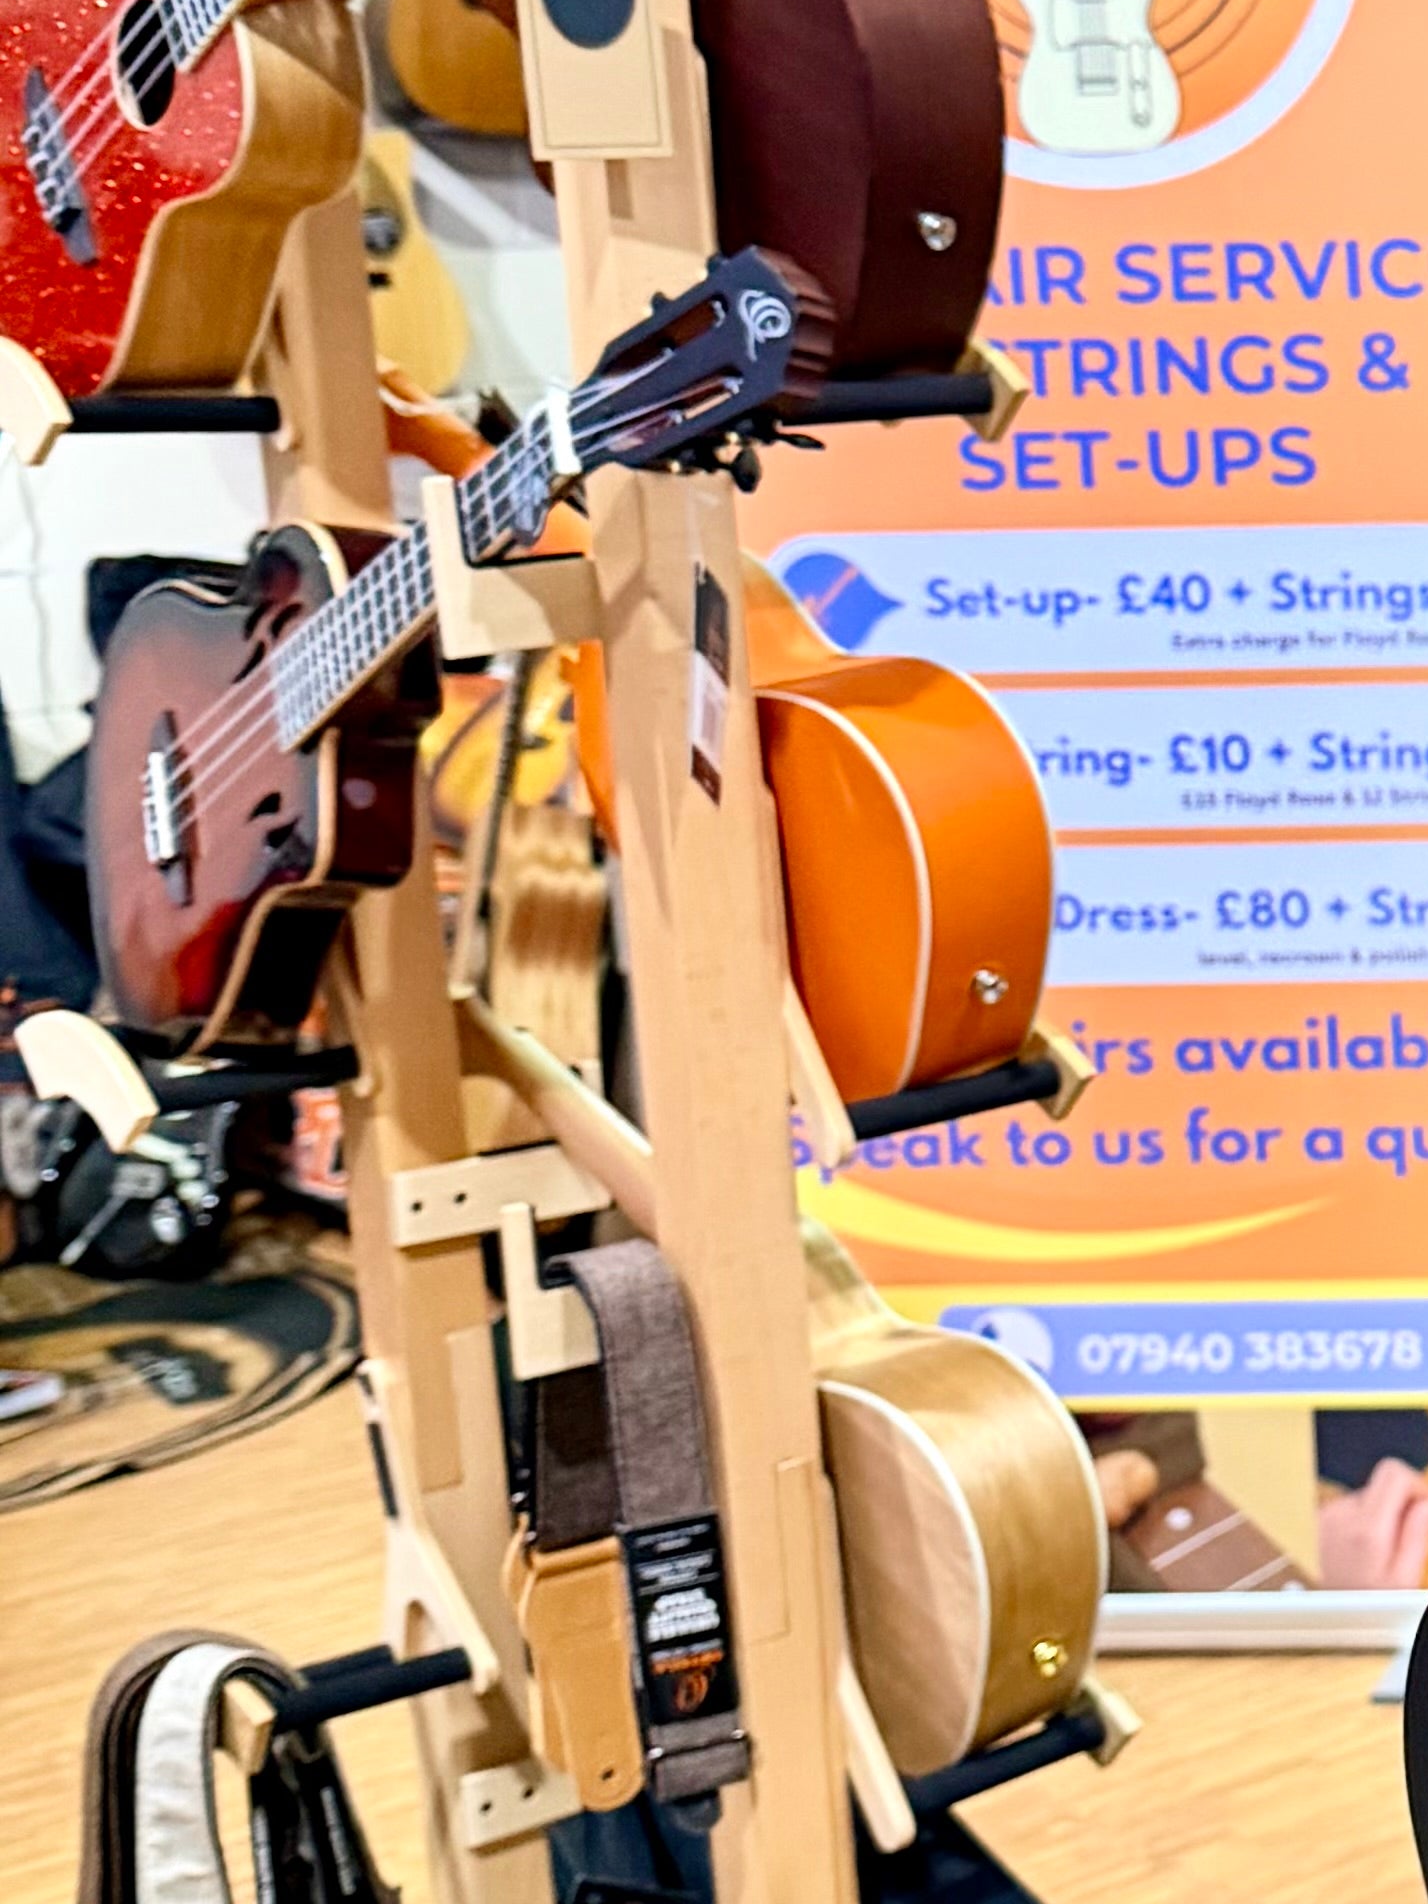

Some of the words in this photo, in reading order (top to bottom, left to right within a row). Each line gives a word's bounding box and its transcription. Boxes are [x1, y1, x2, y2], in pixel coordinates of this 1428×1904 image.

[984, 332, 1330, 398] TRINGS
[1357, 332, 1410, 393] &
[958, 426, 1317, 492] SET-UPS
[924, 577, 1100, 628] Set-up-
[1116, 573, 1212, 615] £40
[1227, 580, 1252, 605] +
[1167, 733, 1252, 775] £10
[1267, 740, 1293, 765] +
[1053, 894, 1198, 932] Dress-
[1214, 890, 1310, 930] £80
[1327, 897, 1353, 920] +
[1005, 1119, 1072, 1167] to
[1093, 1127, 1166, 1165] us
[1186, 1106, 1283, 1164] for
[1303, 1126, 1345, 1162] a
[1078, 1331, 1234, 1375] 07940
[1242, 1328, 1425, 1373] 383678
